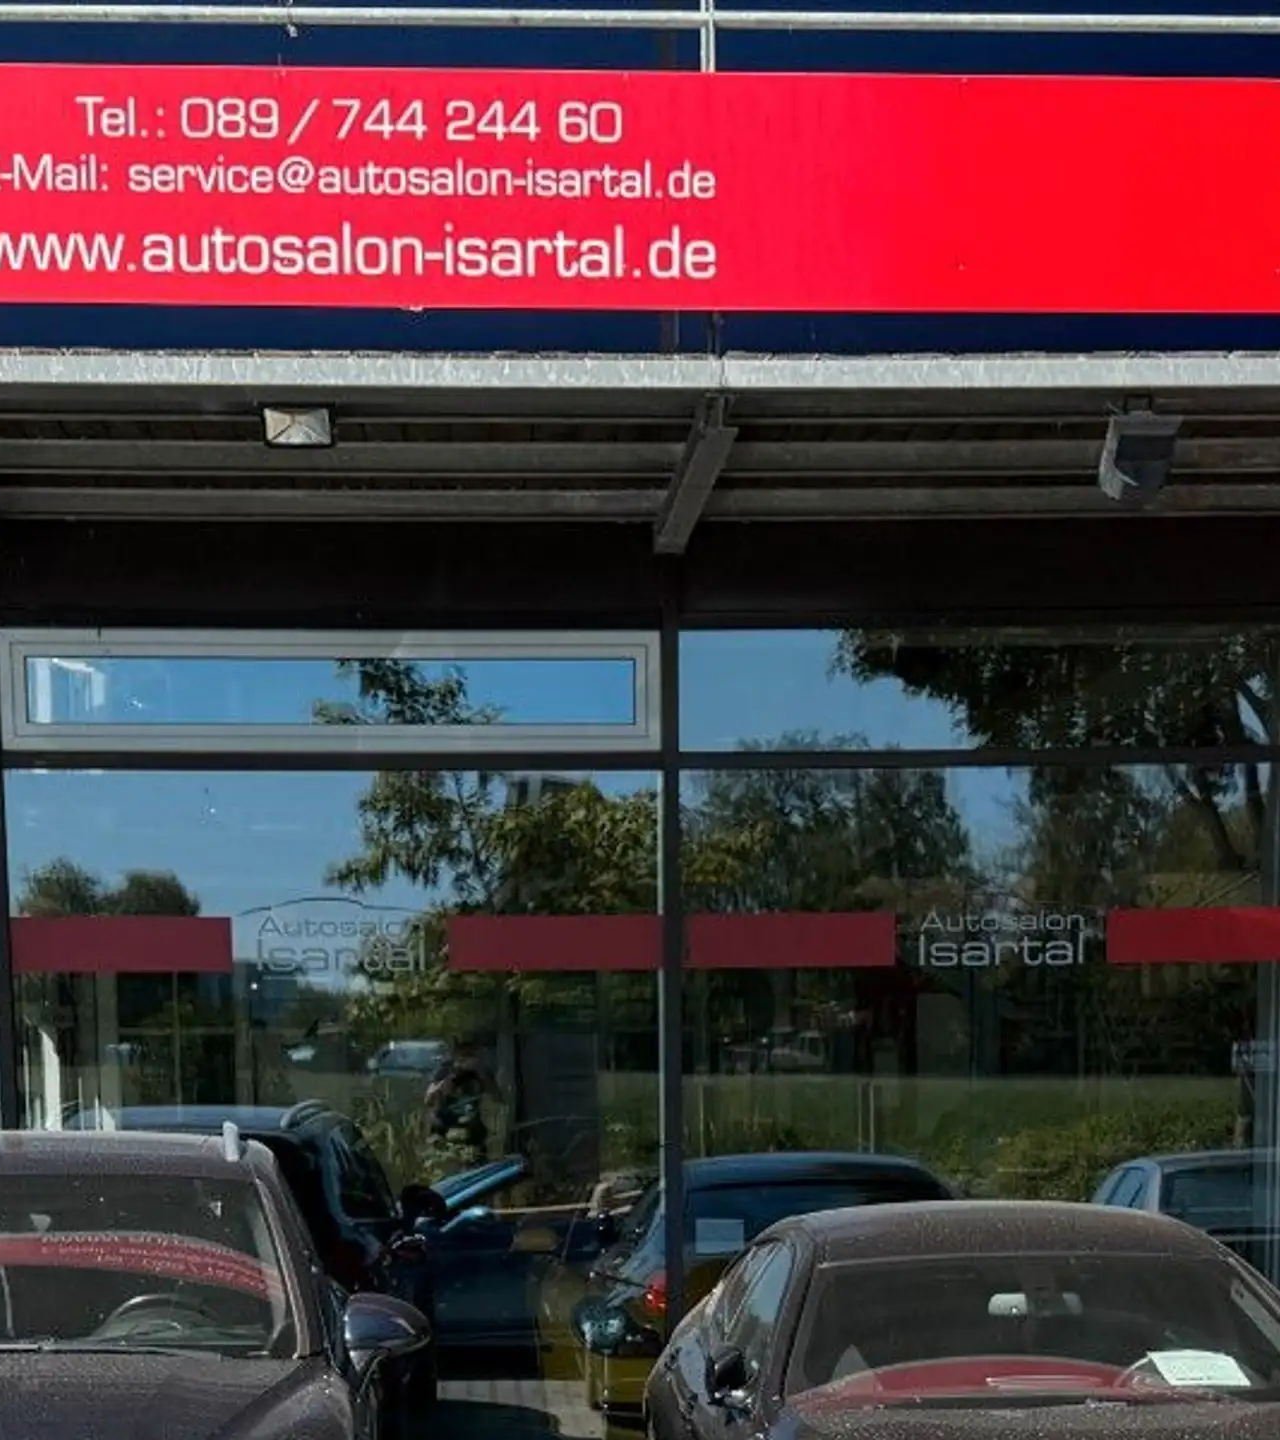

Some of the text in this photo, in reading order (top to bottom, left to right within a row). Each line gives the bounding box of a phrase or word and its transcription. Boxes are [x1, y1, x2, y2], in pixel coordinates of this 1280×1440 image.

[76, 96, 165, 138] Tel.:
[181, 97, 279, 139] 089
[332, 99, 428, 140] 744
[446, 100, 541, 142] 244
[558, 101, 622, 144] 60
[128, 153, 716, 199] service@autosalon-isartal.de
[921, 908, 1086, 932] Autosalon
[918, 933, 1085, 967] Isartal
